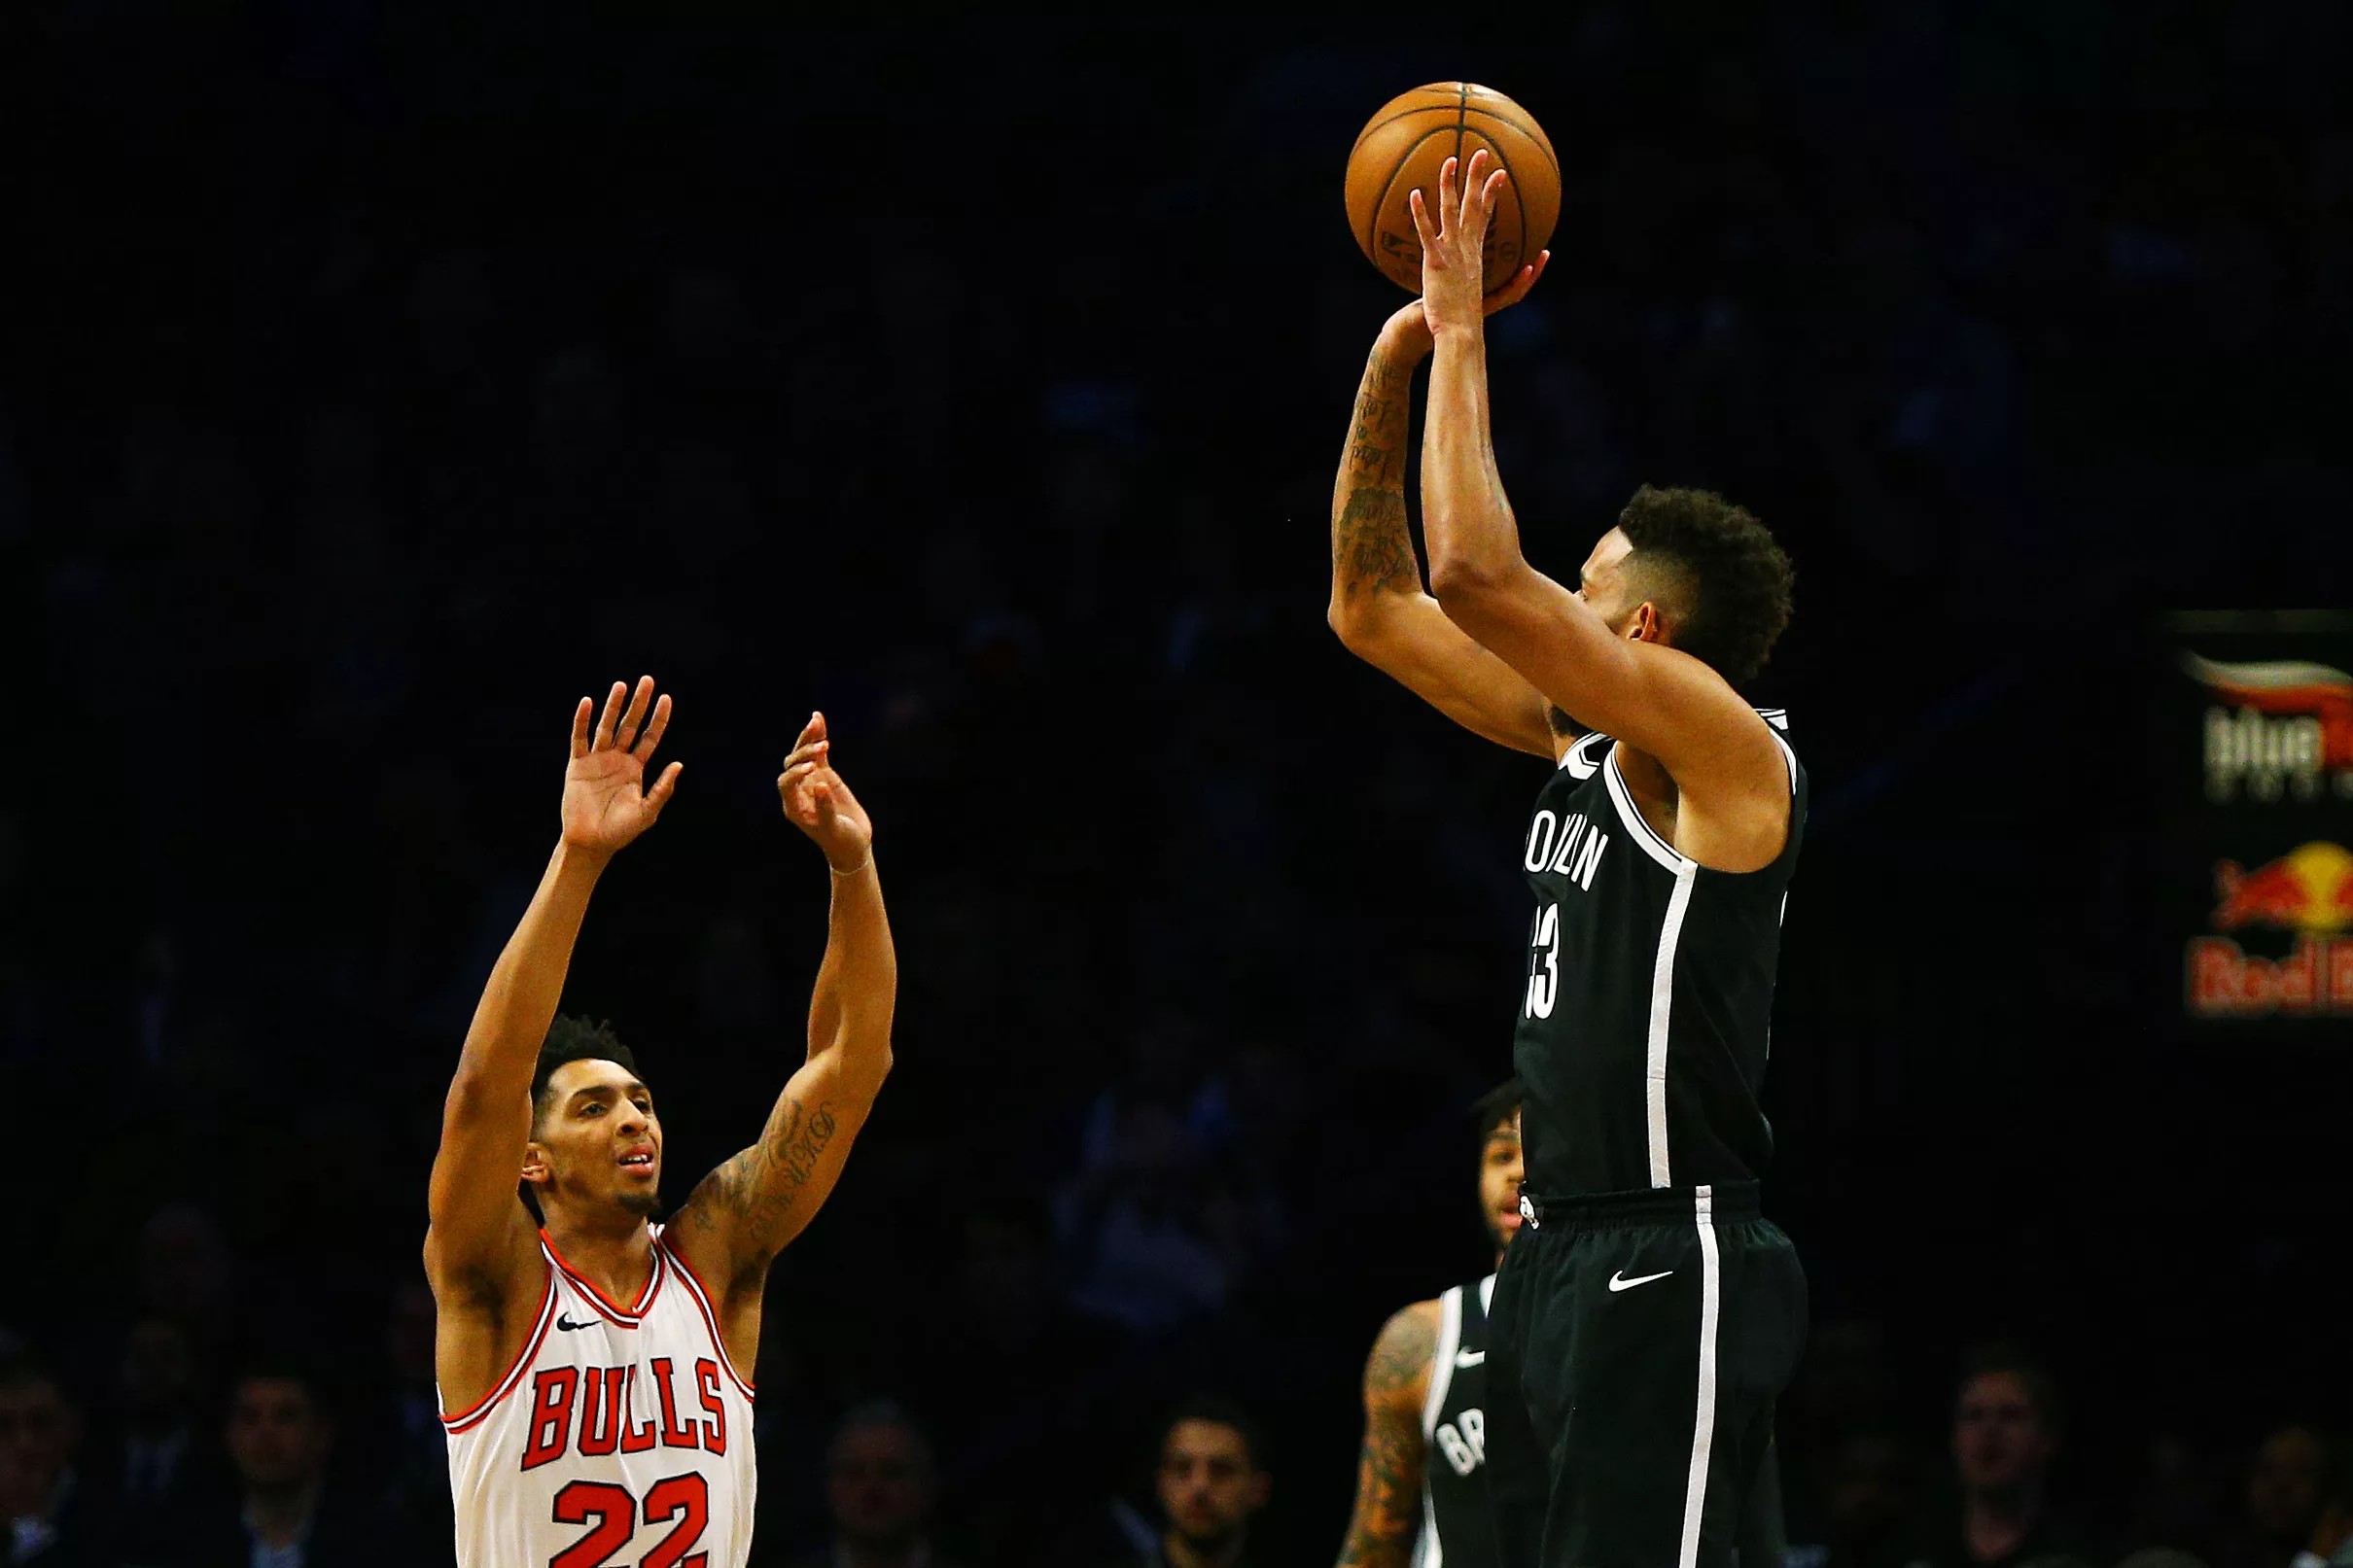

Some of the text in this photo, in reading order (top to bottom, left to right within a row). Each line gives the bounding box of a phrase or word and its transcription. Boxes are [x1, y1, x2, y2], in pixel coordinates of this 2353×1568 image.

[2187, 937, 2322, 1015] Red
[520, 1357, 727, 1472] BULLS
[548, 1471, 710, 1568] 22
